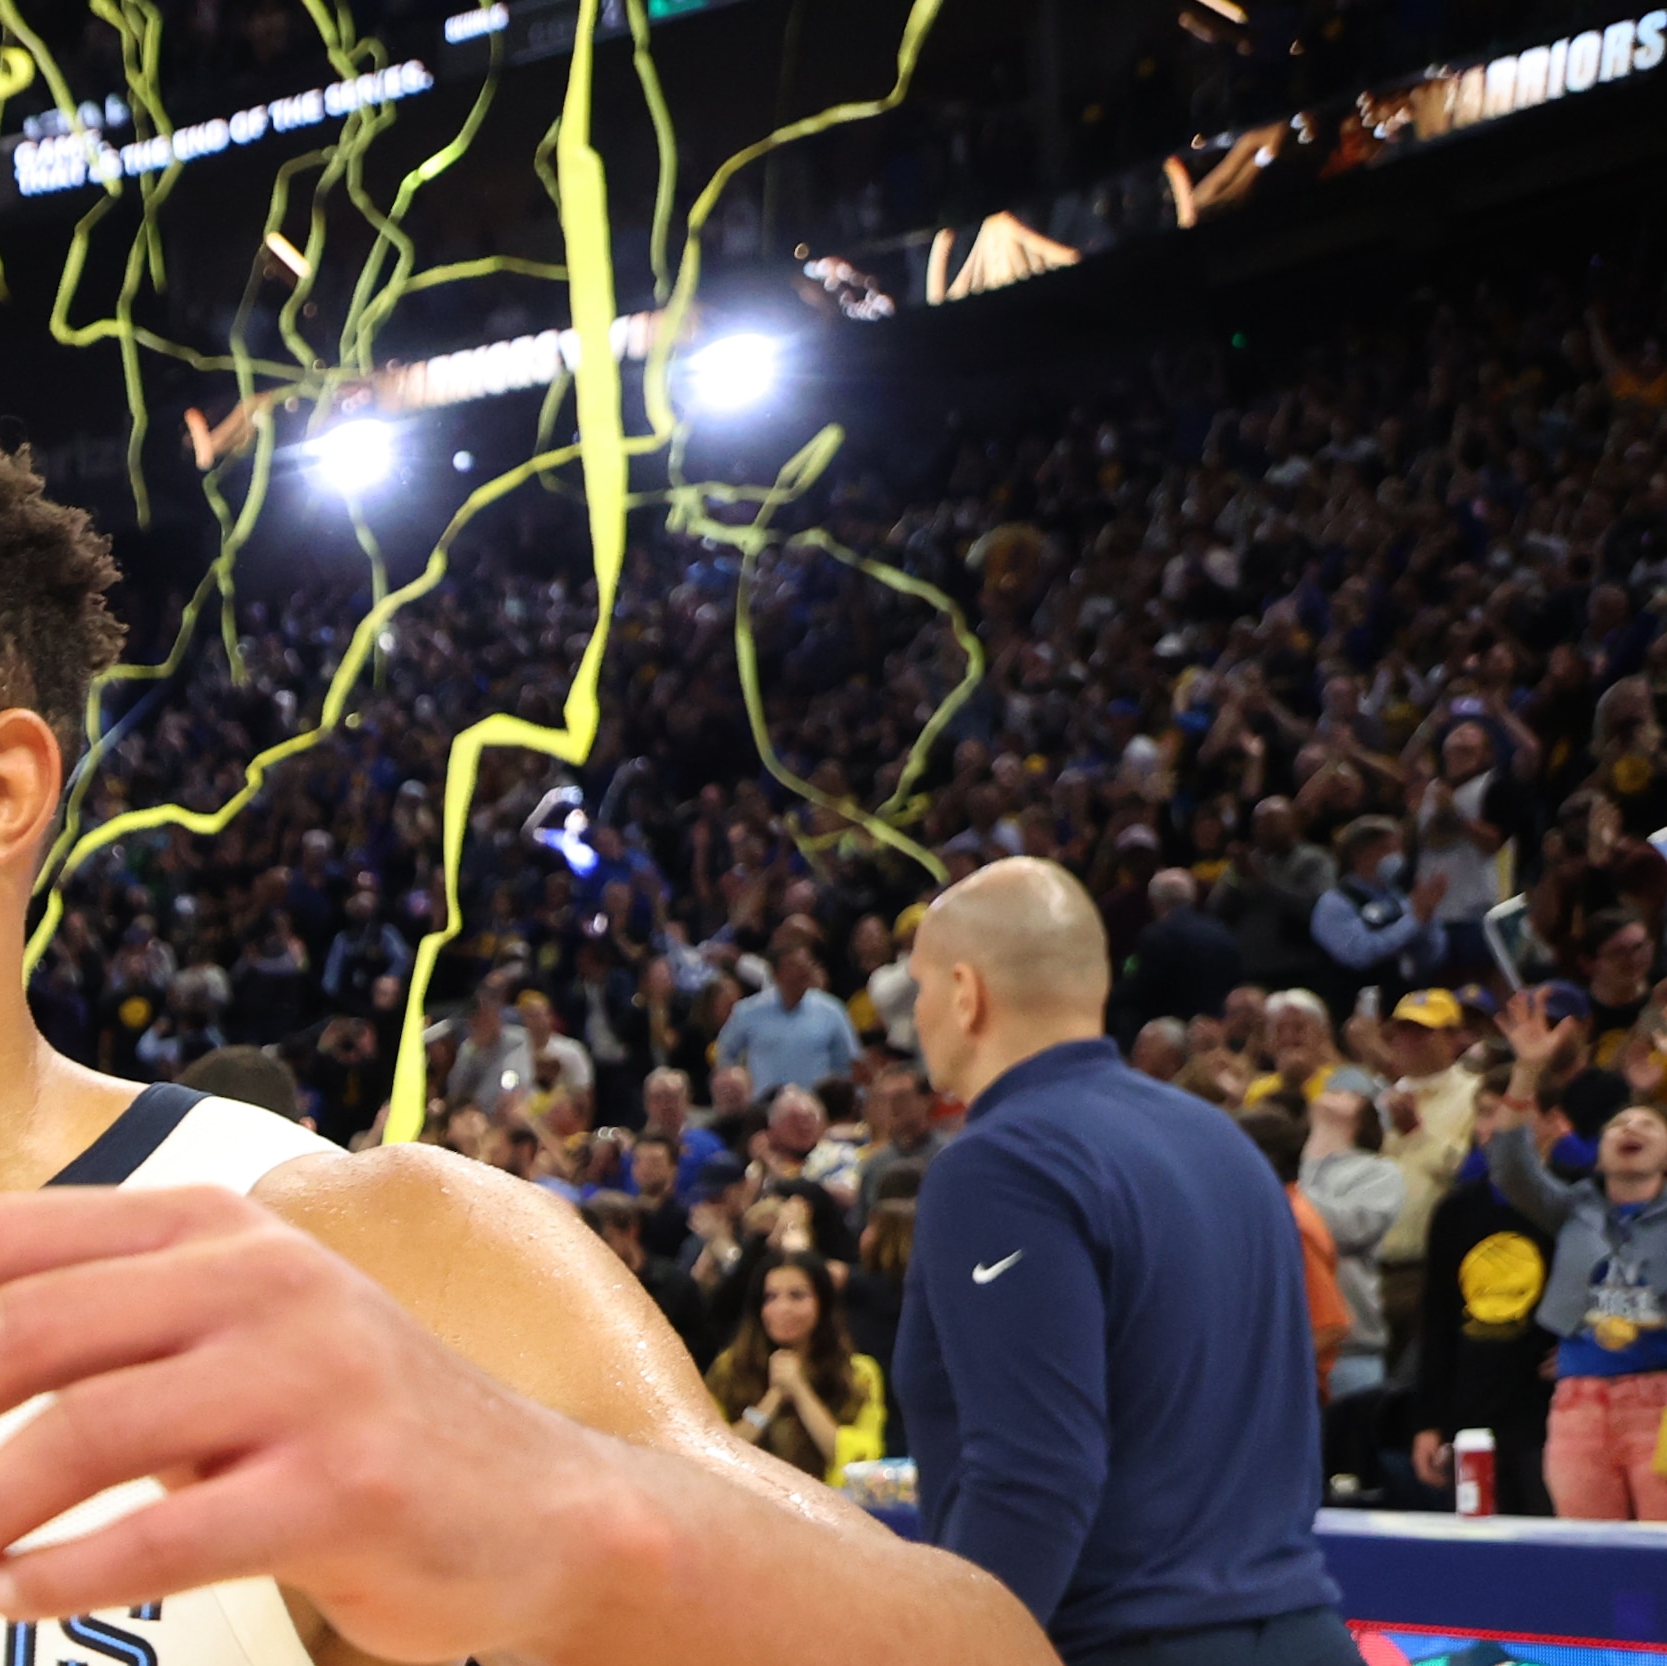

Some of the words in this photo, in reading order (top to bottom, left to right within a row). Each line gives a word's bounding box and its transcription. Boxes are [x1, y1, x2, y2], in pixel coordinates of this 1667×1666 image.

[120, 135, 173, 176] THE
[173, 119, 229, 161] END
[230, 105, 268, 144] OF
[268, 89, 325, 132] THE
